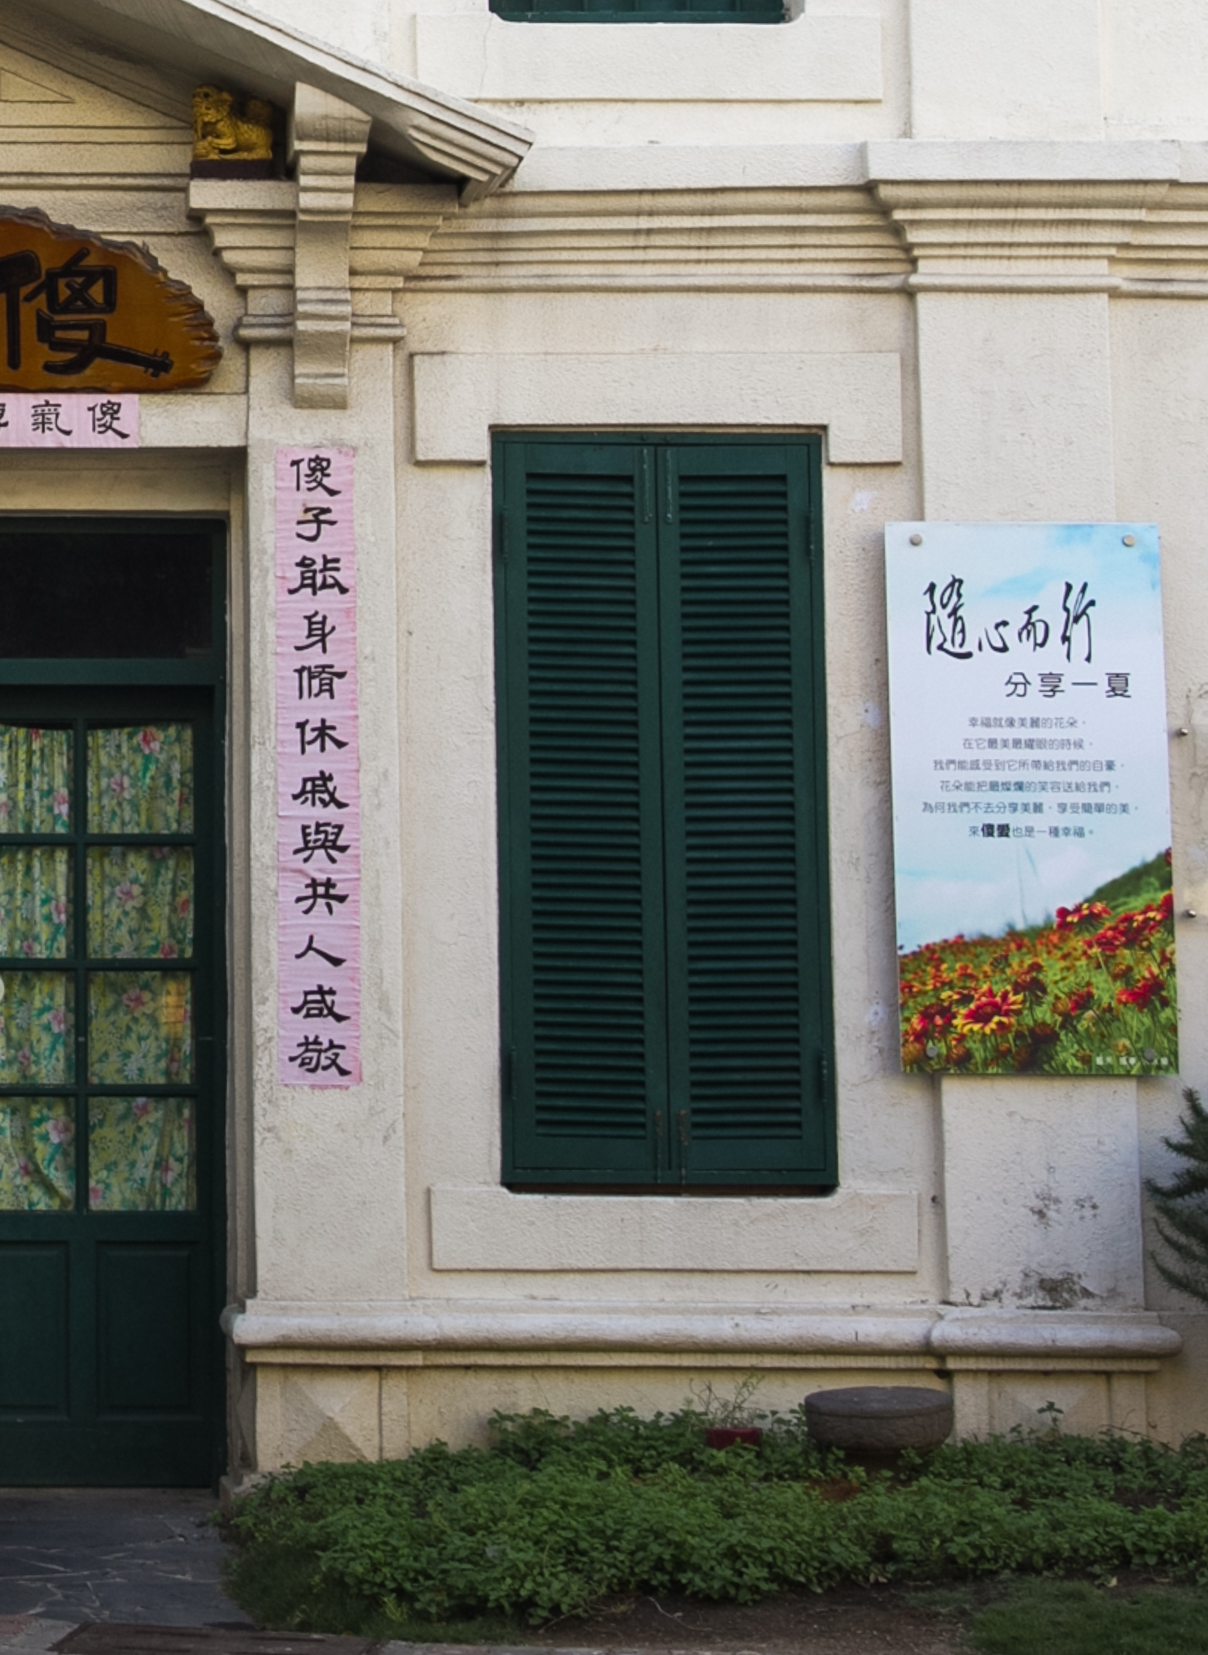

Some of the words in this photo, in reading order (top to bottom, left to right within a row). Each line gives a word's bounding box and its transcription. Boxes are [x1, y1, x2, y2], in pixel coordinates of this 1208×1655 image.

[923, 574, 1097, 664] 隨心而行
[1004, 671, 1132, 698] 分享一夏
